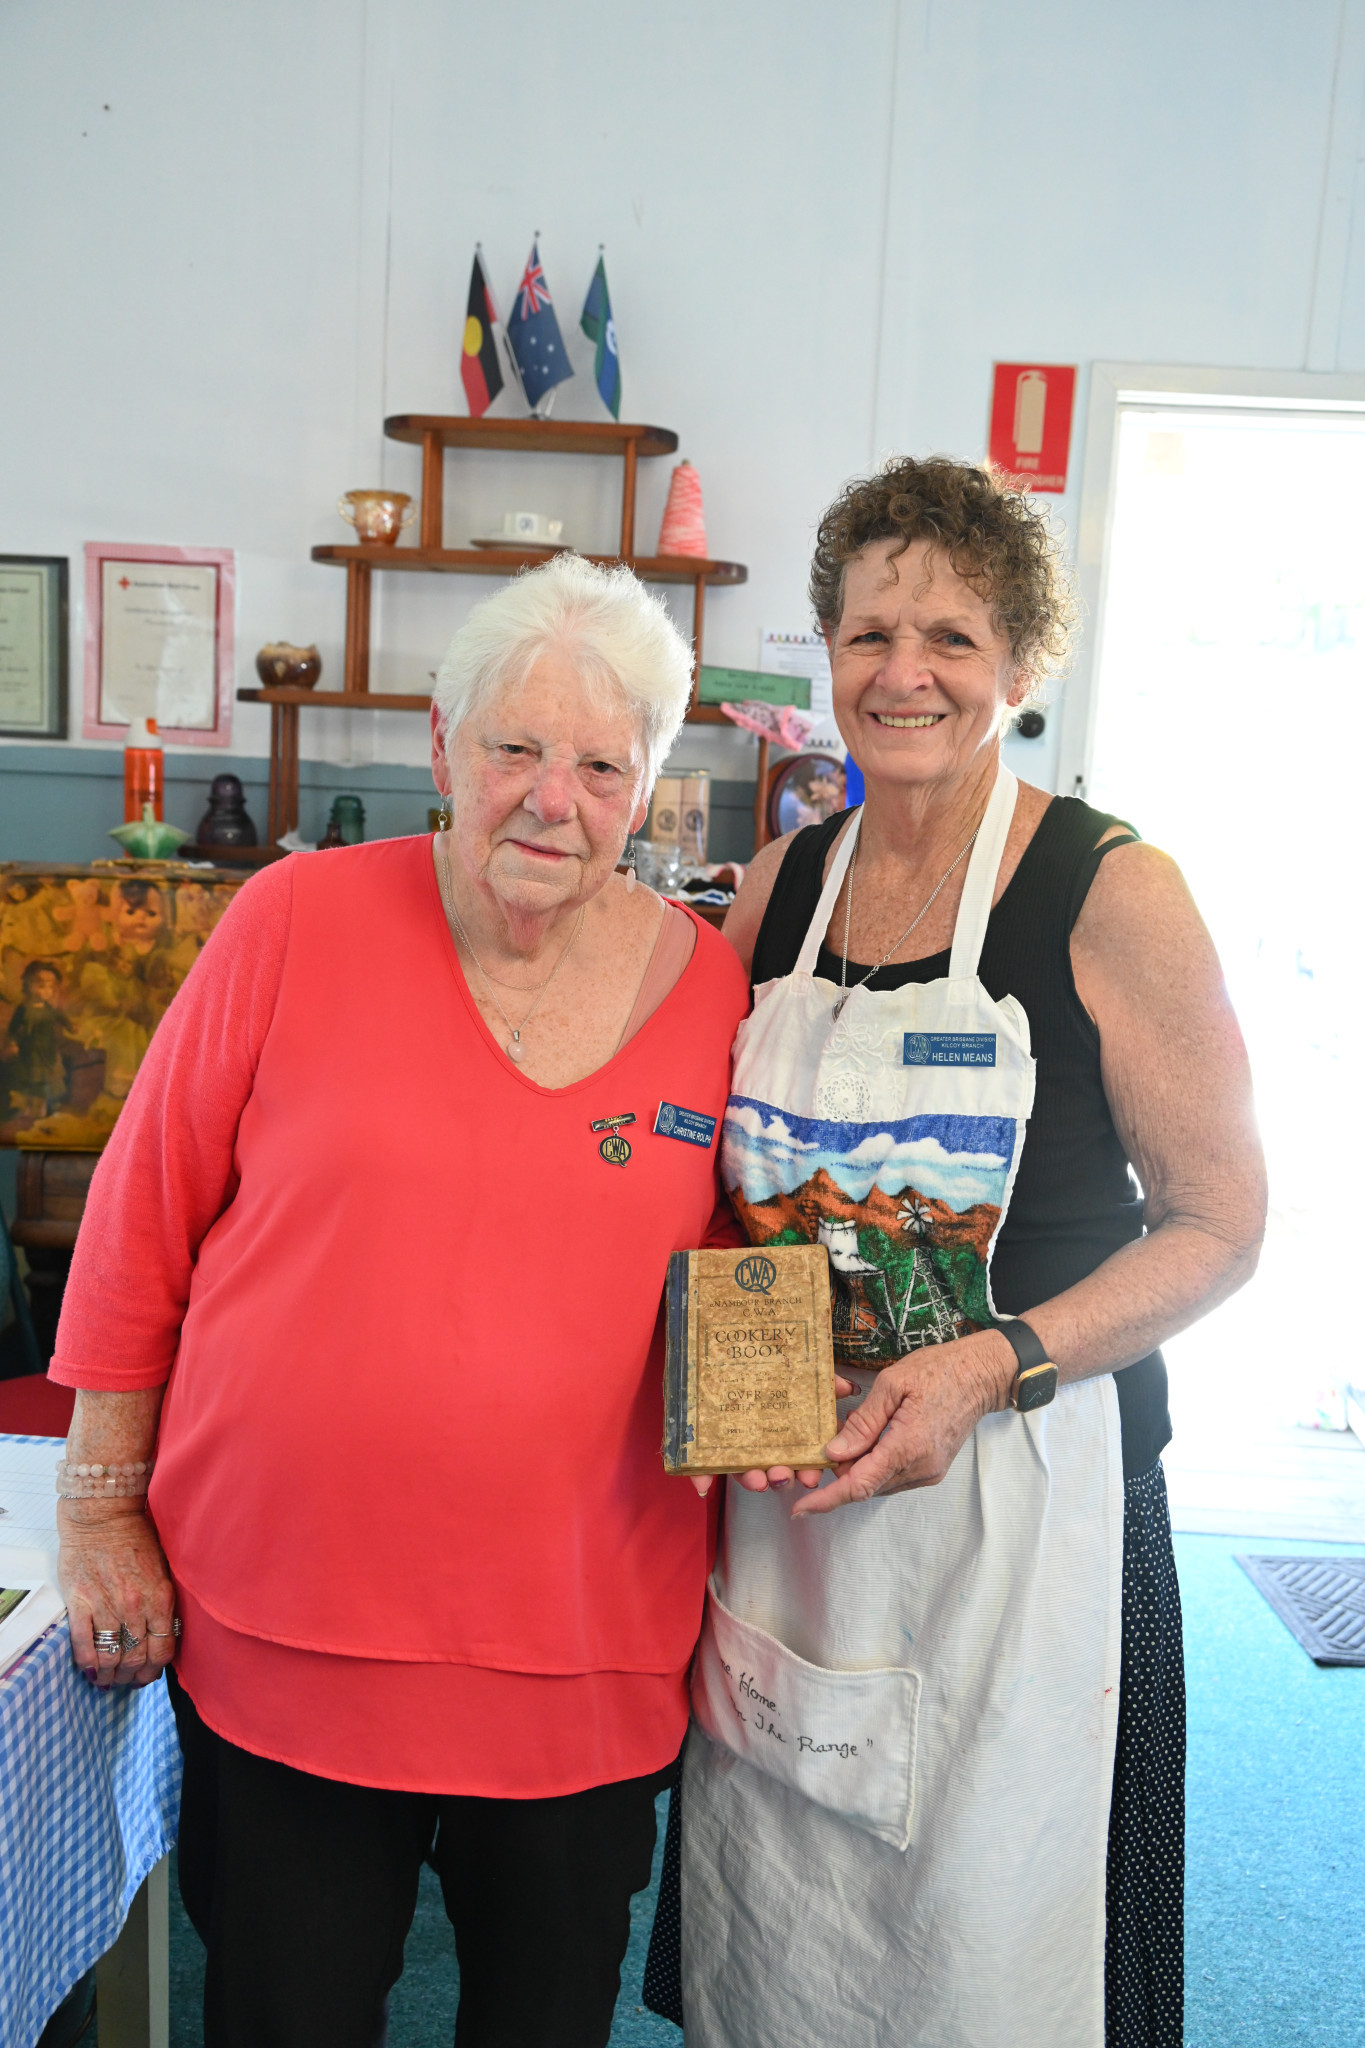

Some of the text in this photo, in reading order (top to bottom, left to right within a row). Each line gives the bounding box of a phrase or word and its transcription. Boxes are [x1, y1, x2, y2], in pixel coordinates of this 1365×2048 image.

[932, 1052, 993, 1062] HELEN MEANS
[673, 1125, 712, 1144] CHRISTINE ROLPH
[710, 1297, 802, 1308] NAMBOUR BRANCH
[715, 1327, 796, 1343] COOKERY
[727, 1345, 785, 1359] BOOK
[727, 1390, 788, 1400] OVER 500
[755, 1712, 787, 1743] The
